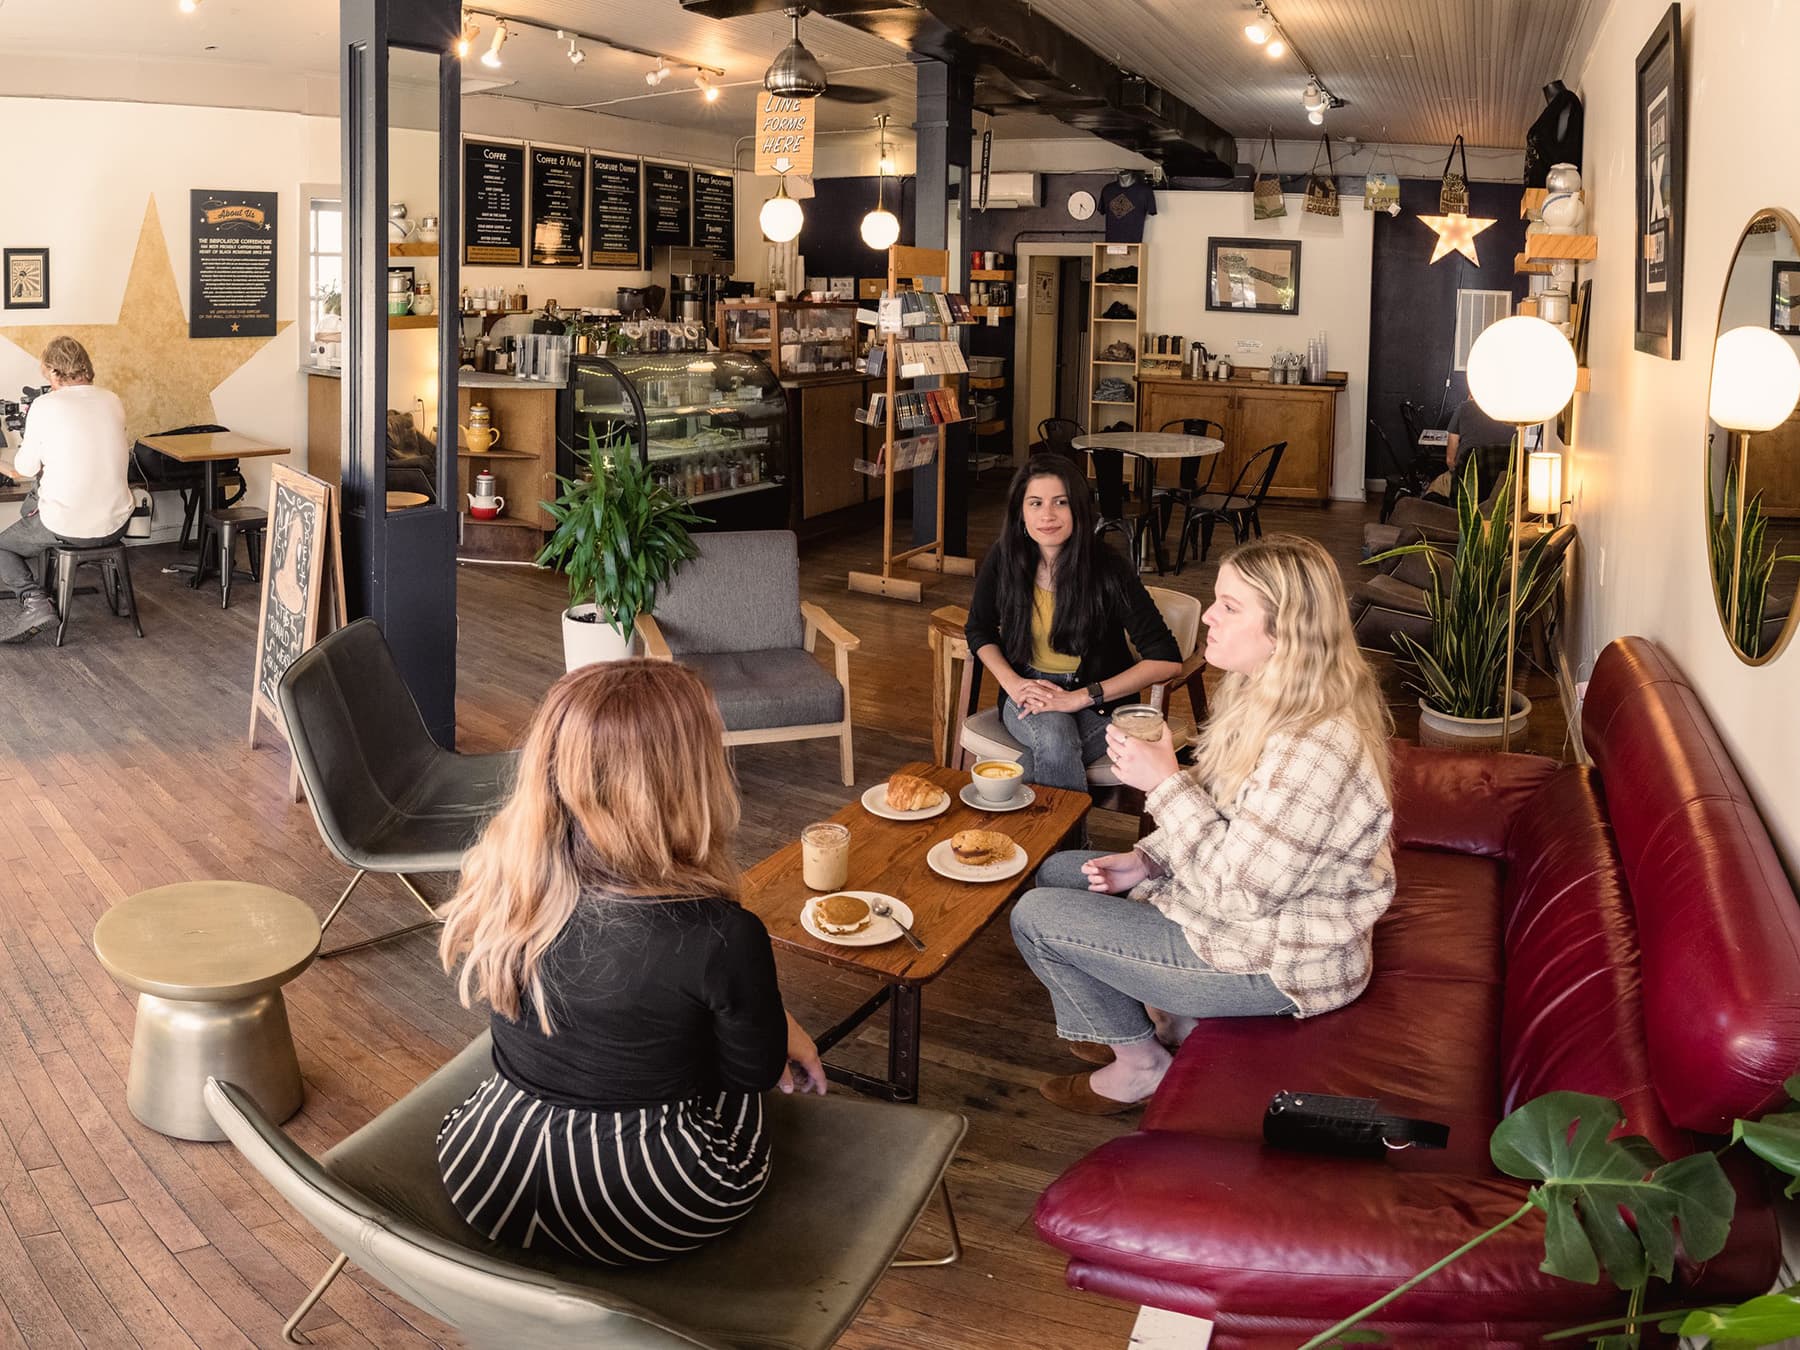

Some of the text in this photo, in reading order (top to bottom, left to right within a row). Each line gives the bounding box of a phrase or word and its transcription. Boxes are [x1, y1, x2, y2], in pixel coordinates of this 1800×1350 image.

[765, 95, 801, 113] LINE
[763, 116, 806, 132] FORMS
[763, 135, 805, 153] HERE
[559, 155, 565, 166] &
[217, 209, 256, 219] About Us
